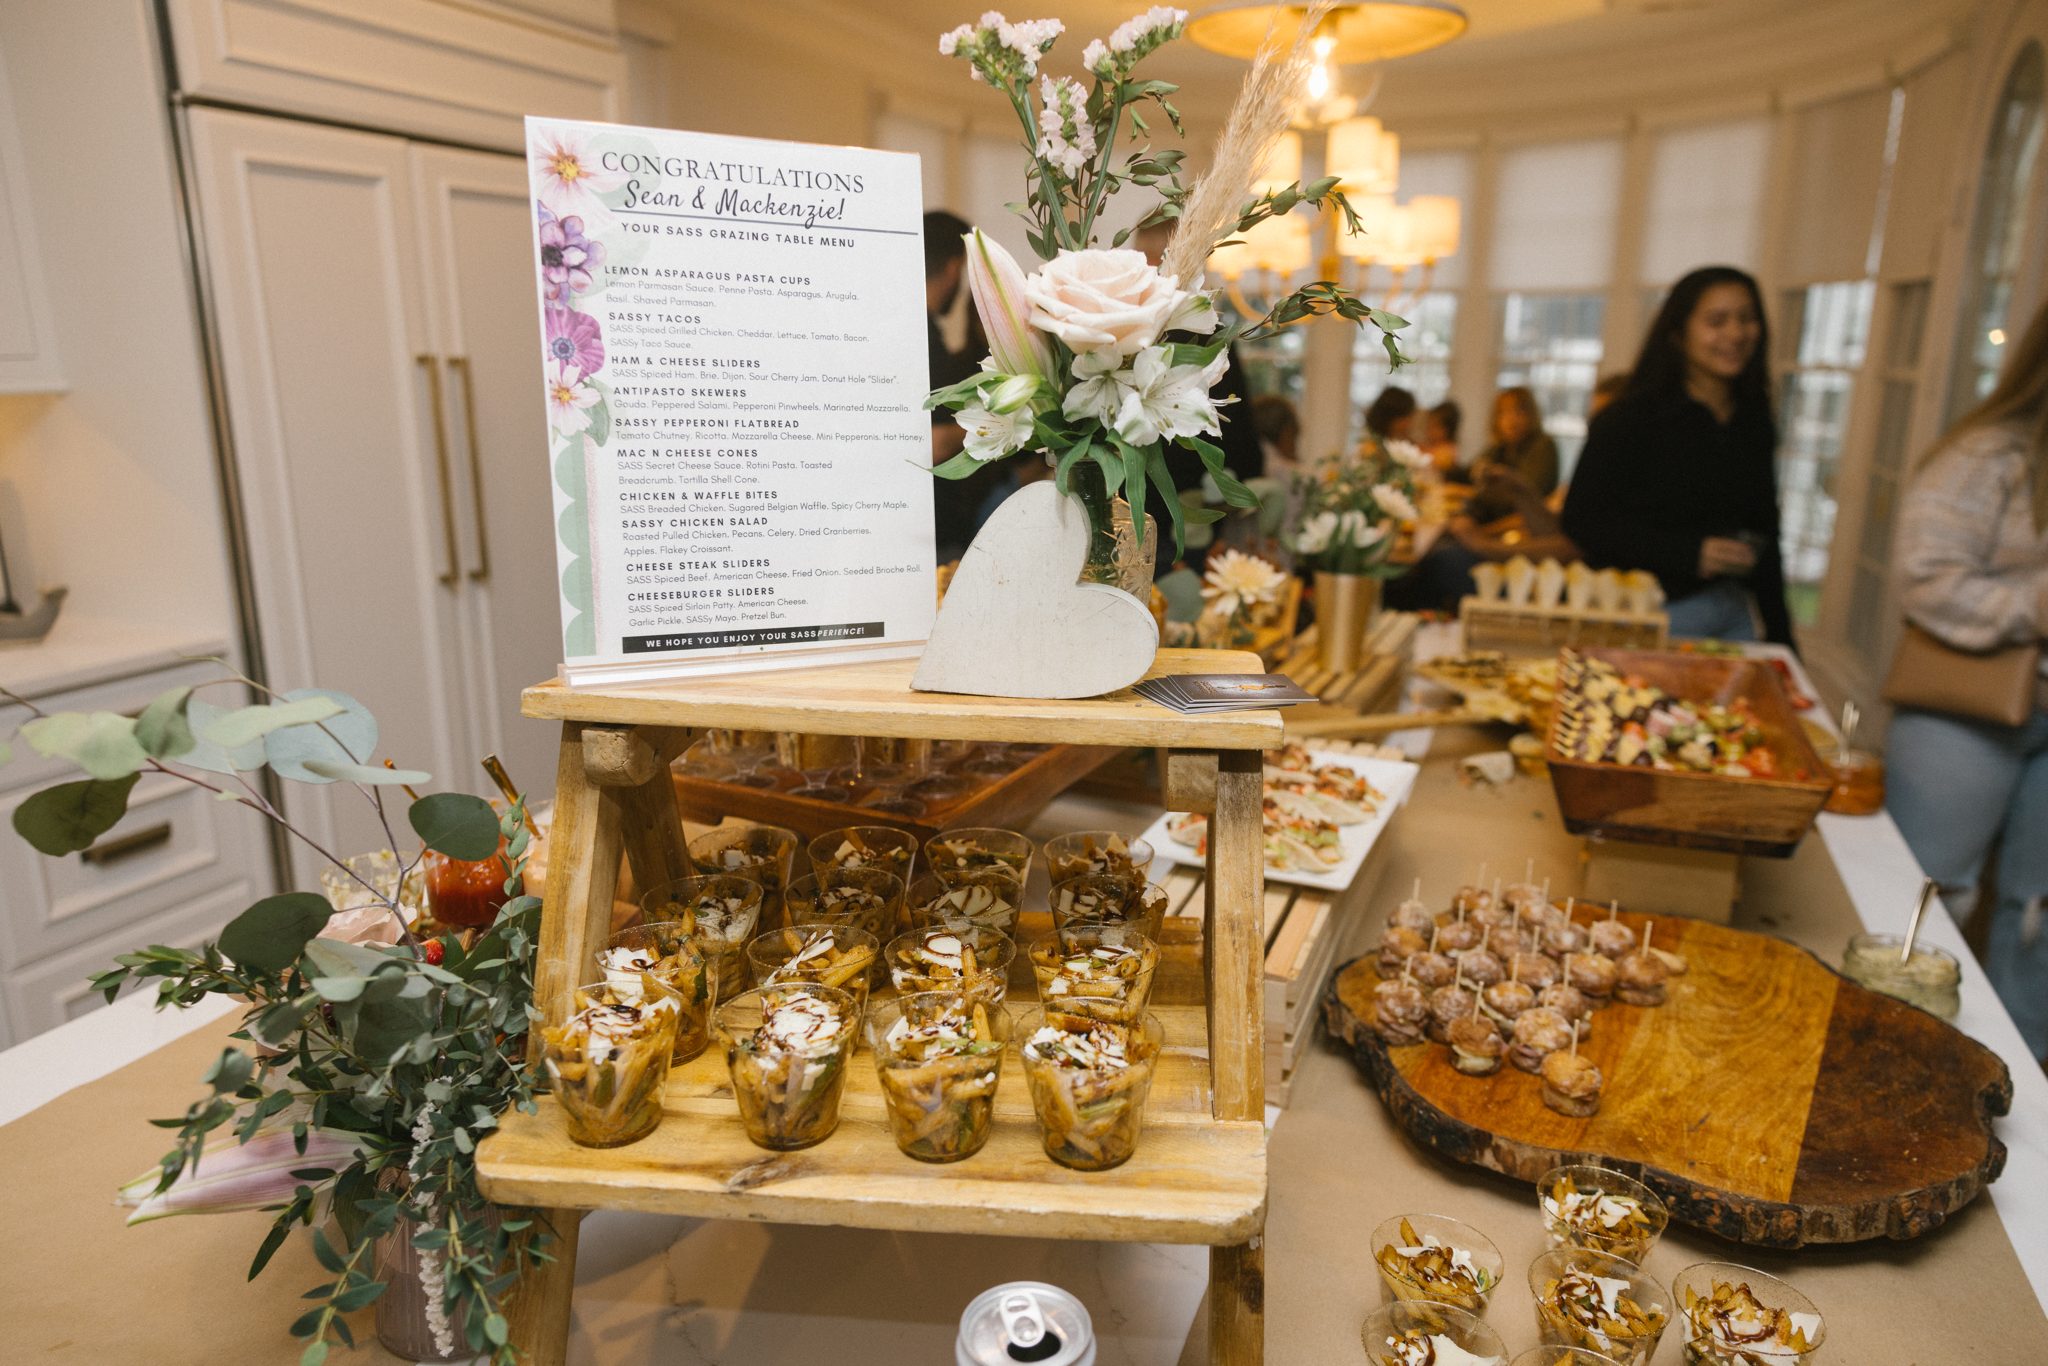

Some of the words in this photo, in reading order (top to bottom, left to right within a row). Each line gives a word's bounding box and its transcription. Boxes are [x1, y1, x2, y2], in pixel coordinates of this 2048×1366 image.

[602, 151, 864, 194] CONGRATULATIONS
[623, 179, 683, 209] Sean
[692, 185, 706, 211] &
[715, 188, 846, 230] Mackenzie!
[622, 223, 659, 235] YOUR
[666, 226, 703, 238] SASS
[710, 229, 769, 243] GRAZING
[776, 234, 814, 246] TABLE
[820, 236, 854, 248] MENU
[605, 266, 648, 277] LEMON
[656, 269, 731, 281] ASPARAGUS
[736, 274, 775, 284] PASTA
[780, 276, 811, 286] CUPS
[605, 280, 636, 289] Lemon
[719, 286, 746, 295] Penne
[633, 296, 668, 306] Shaved
[609, 313, 651, 322] SASSY
[658, 314, 701, 324] TACOS
[609, 325, 634, 334] SASS
[636, 326, 666, 337] Spiced
[668, 327, 697, 336] Grilled
[610, 338, 639, 349] SASSy
[641, 339, 662, 348] Taco
[612, 357, 640, 365] HAM
[646, 358, 653, 366] &
[660, 358, 706, 367] CHEESE
[712, 359, 760, 368] SLIDERS
[612, 370, 638, 378] SASS
[640, 370, 672, 381] Spiced
[749, 373, 768, 381] Sour
[771, 373, 799, 384] Cherry
[822, 375, 846, 383] Donut
[848, 375, 866, 384] Hole
[614, 388, 685, 397] ANTIPASTO
[692, 389, 746, 398] SKEWERS
[652, 401, 696, 412] Peppered
[733, 402, 776, 413] Pepperoni
[823, 404, 864, 412] Marinated
[615, 419, 657, 428] SASSY
[664, 420, 728, 428] PEPPERONI
[734, 420, 799, 428] FLATBREAD
[616, 432, 651, 440] Tomato
[732, 433, 778, 441] Mozzarella
[816, 433, 833, 441] Mini
[884, 433, 897, 441] Hot
[617, 450, 646, 458] MAC
[666, 450, 711, 458] CHEESE
[718, 450, 758, 458] CONES
[618, 462, 643, 470] SASS
[646, 462, 675, 470] Secret
[678, 462, 712, 470] Cheese
[746, 462, 770, 470] Rotini
[800, 461, 833, 469] Toasted
[678, 476, 709, 485] Tortilla
[710, 476, 732, 484] Shell
[620, 492, 675, 501] CHICKEN
[682, 492, 688, 500] &
[694, 492, 740, 500] WAFFLE
[746, 491, 778, 500] BITES
[620, 506, 646, 514] SASS
[648, 505, 686, 513] Breaded
[729, 504, 765, 514] Sugared
[767, 503, 798, 513] Belgian
[831, 502, 853, 512] Spicy
[855, 502, 881, 512] Cherry
[622, 520, 664, 529] SASSY
[670, 518, 724, 528] CHICKEN
[730, 517, 768, 526] SALAD
[623, 532, 660, 541] Roasted
[663, 531, 690, 540] Pulled
[799, 528, 821, 536] Dried
[823, 527, 872, 536] Cranberries.
[660, 546, 688, 557] Flakey
[626, 563, 673, 572] CHEESE
[679, 561, 717, 570] STEAK
[723, 559, 770, 569] SLIDERS
[626, 576, 652, 585] SASS
[654, 574, 686, 586] Spiced
[713, 572, 754, 581] American
[792, 569, 813, 578] Fried
[843, 567, 874, 576] Seeded
[876, 566, 905, 575] Brioche
[628, 590, 722, 602] CHEESEBURGER
[728, 587, 774, 597] SLIDERS
[628, 605, 652, 614] SASS
[654, 603, 683, 615] Spiced
[685, 602, 711, 611] Sirloin
[738, 599, 776, 609] American
[629, 618, 655, 627] Garlic
[686, 615, 713, 626] SASSy
[741, 612, 768, 622] Pretzel
[646, 639, 662, 648] WE
[666, 637, 693, 647] HOPE
[697, 636, 719, 645] YOU
[723, 633, 756, 644] ENJOY
[760, 632, 787, 641] YOUR
[791, 627, 864, 640] SASSPERIENCE!
